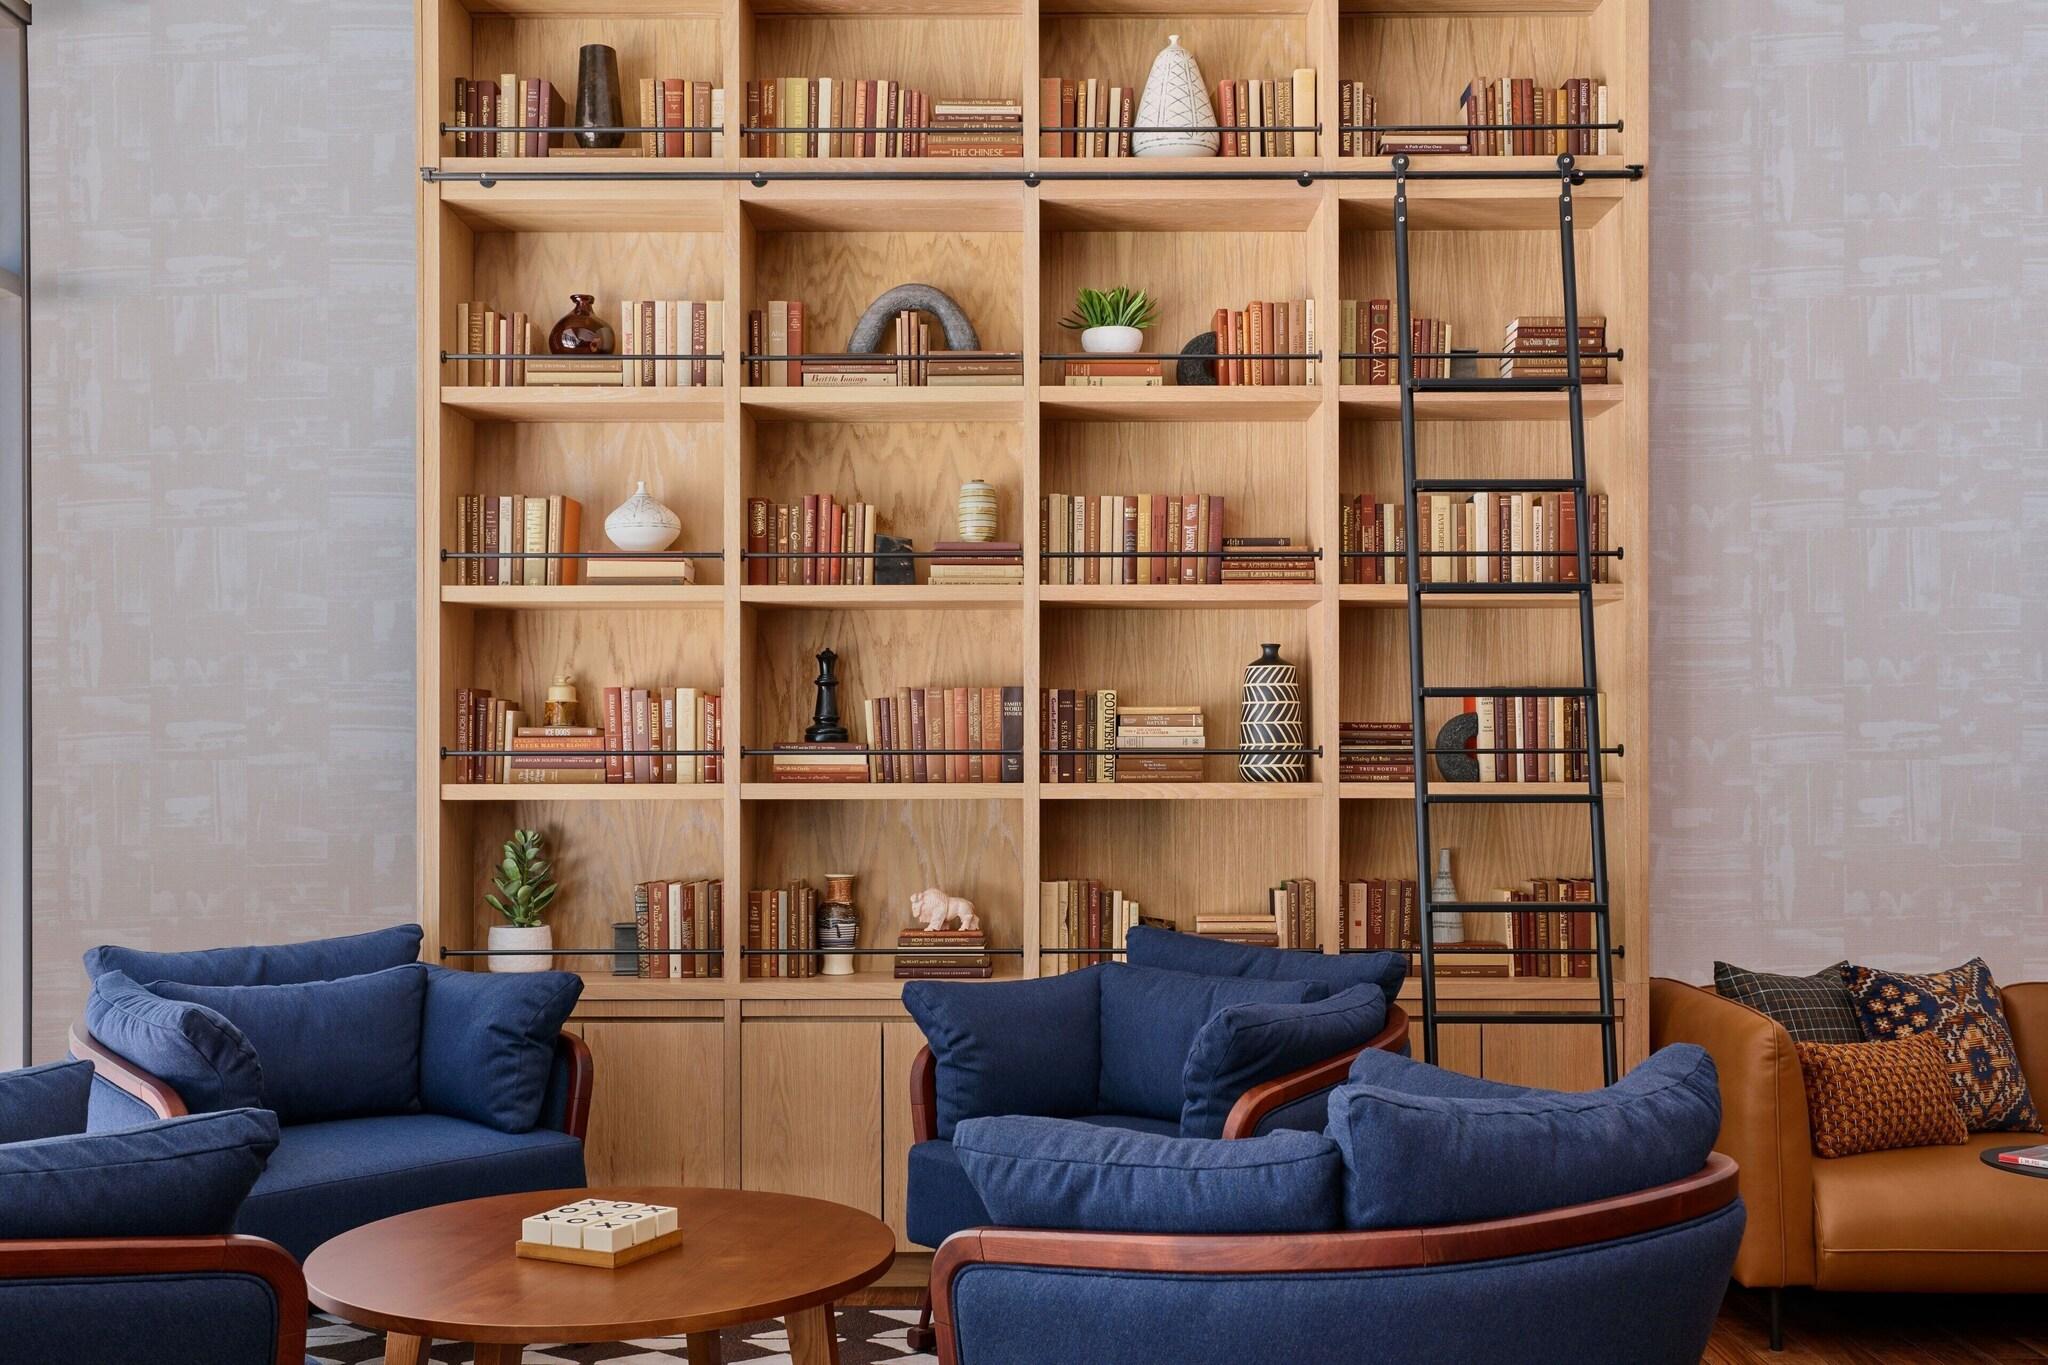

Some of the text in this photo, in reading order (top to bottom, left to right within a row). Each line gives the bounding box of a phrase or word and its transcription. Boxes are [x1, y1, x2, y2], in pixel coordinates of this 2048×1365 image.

[1343, 84, 1351, 102] SANDRA
[1343, 102, 1351, 120] BROWN
[1343, 132, 1351, 152] TUESDAY
[950, 148, 1004, 157] THE CHINESE
[1370, 327, 1388, 381] CAEAR
[811, 374, 868, 384] Brittle Innings
[1076, 501, 1084, 533] INFIDEL
[459, 691, 466, 702] TO
[609, 694, 617, 714] HERMAN
[544, 728, 571, 736] ICE DOGS
[932, 730, 941, 747] York
[1373, 888, 1383, 935] LADY'S MAID
